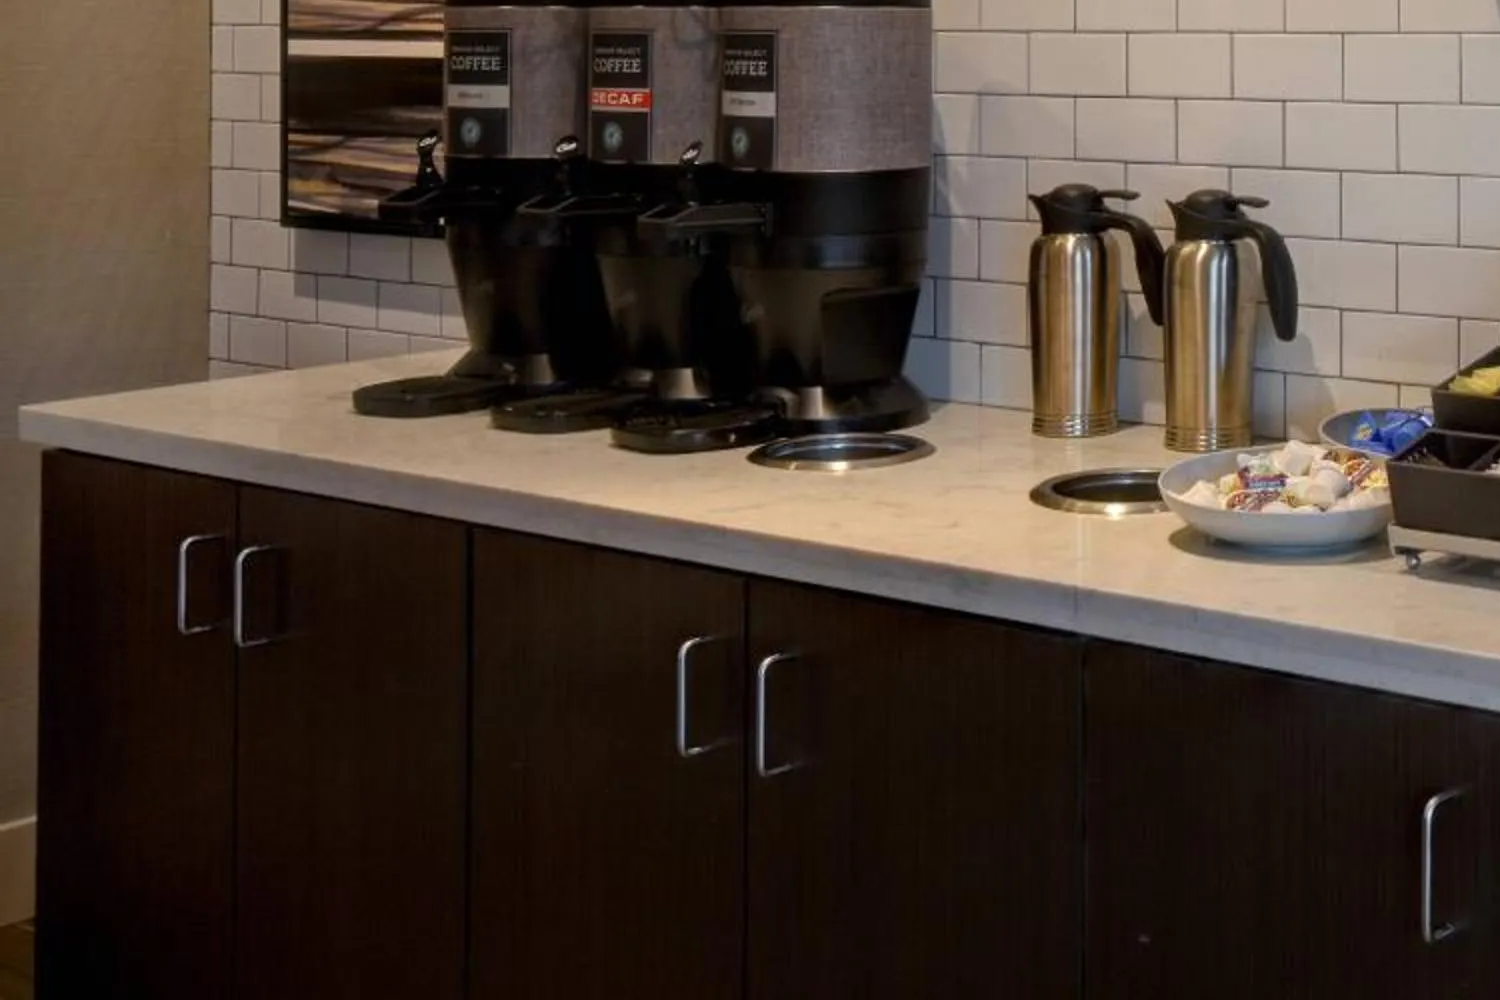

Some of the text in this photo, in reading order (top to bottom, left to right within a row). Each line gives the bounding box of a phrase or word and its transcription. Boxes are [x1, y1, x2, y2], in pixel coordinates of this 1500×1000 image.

[451, 55, 501, 71] COFFEE
[593, 58, 642, 73] COFFEE
[724, 60, 768, 75] COFFEE
